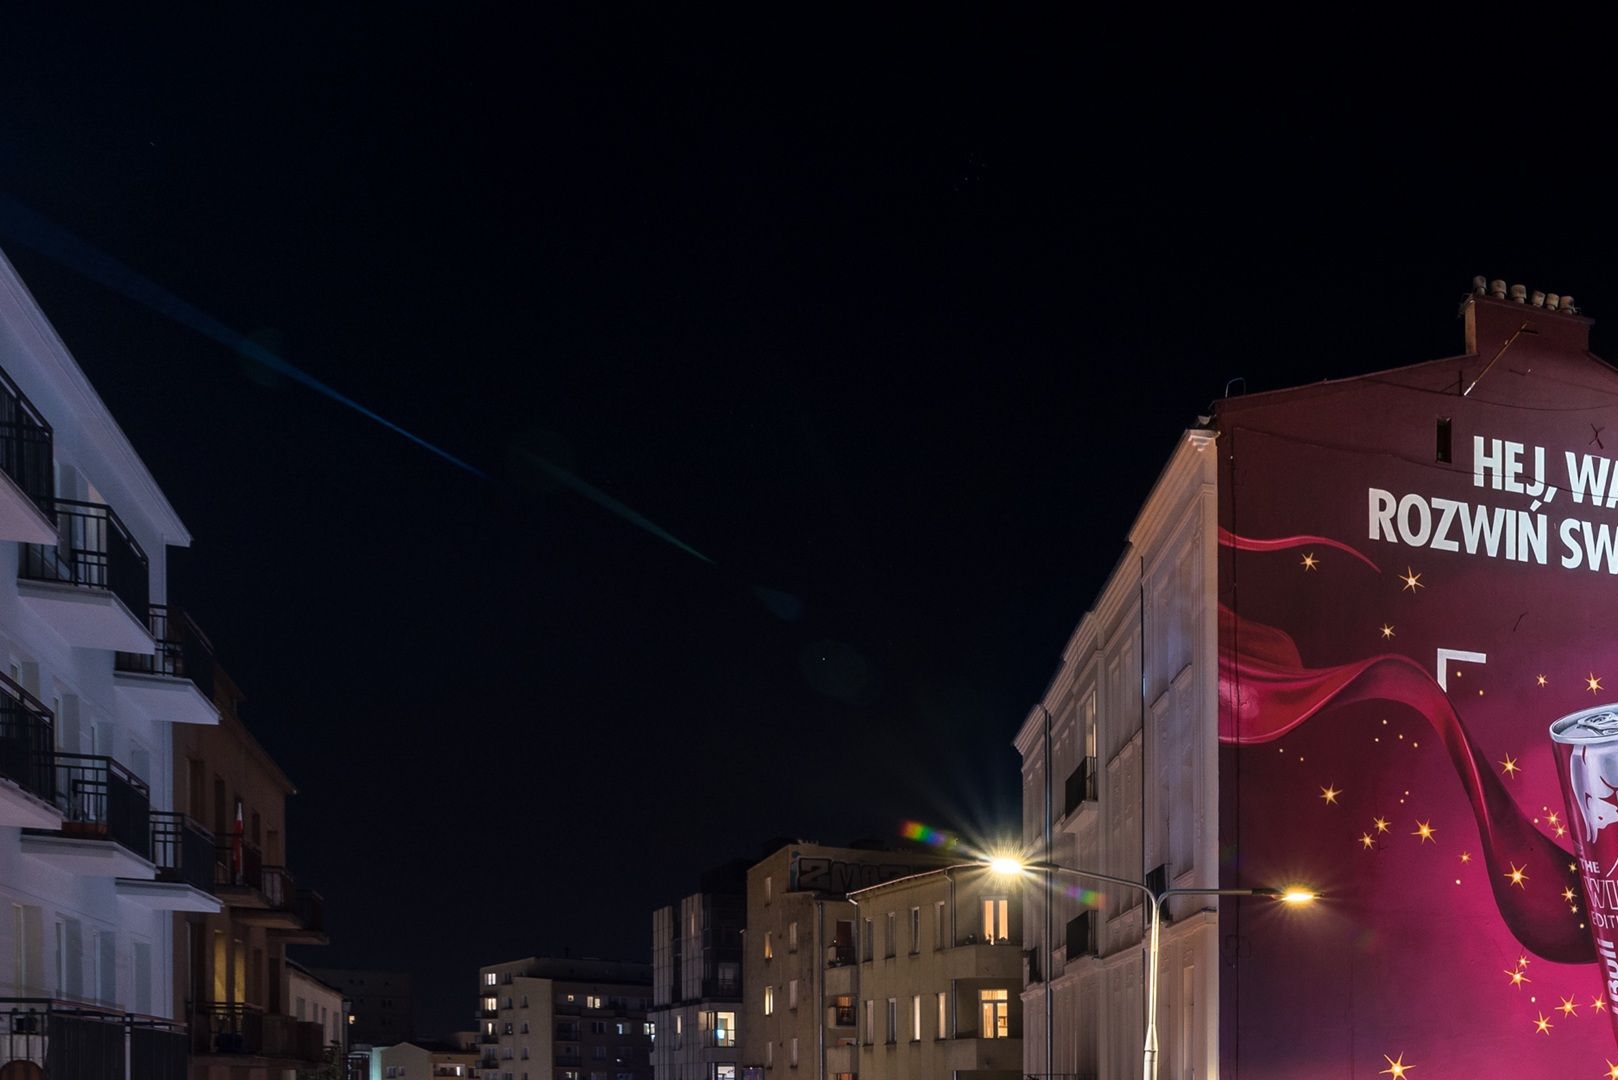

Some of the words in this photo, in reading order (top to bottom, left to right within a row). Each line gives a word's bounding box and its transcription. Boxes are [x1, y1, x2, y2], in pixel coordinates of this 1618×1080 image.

[1473, 436, 1557, 505] HEJ,
[1368, 487, 1548, 565] ROZWIŃ
[1580, 858, 1600, 873] THE
